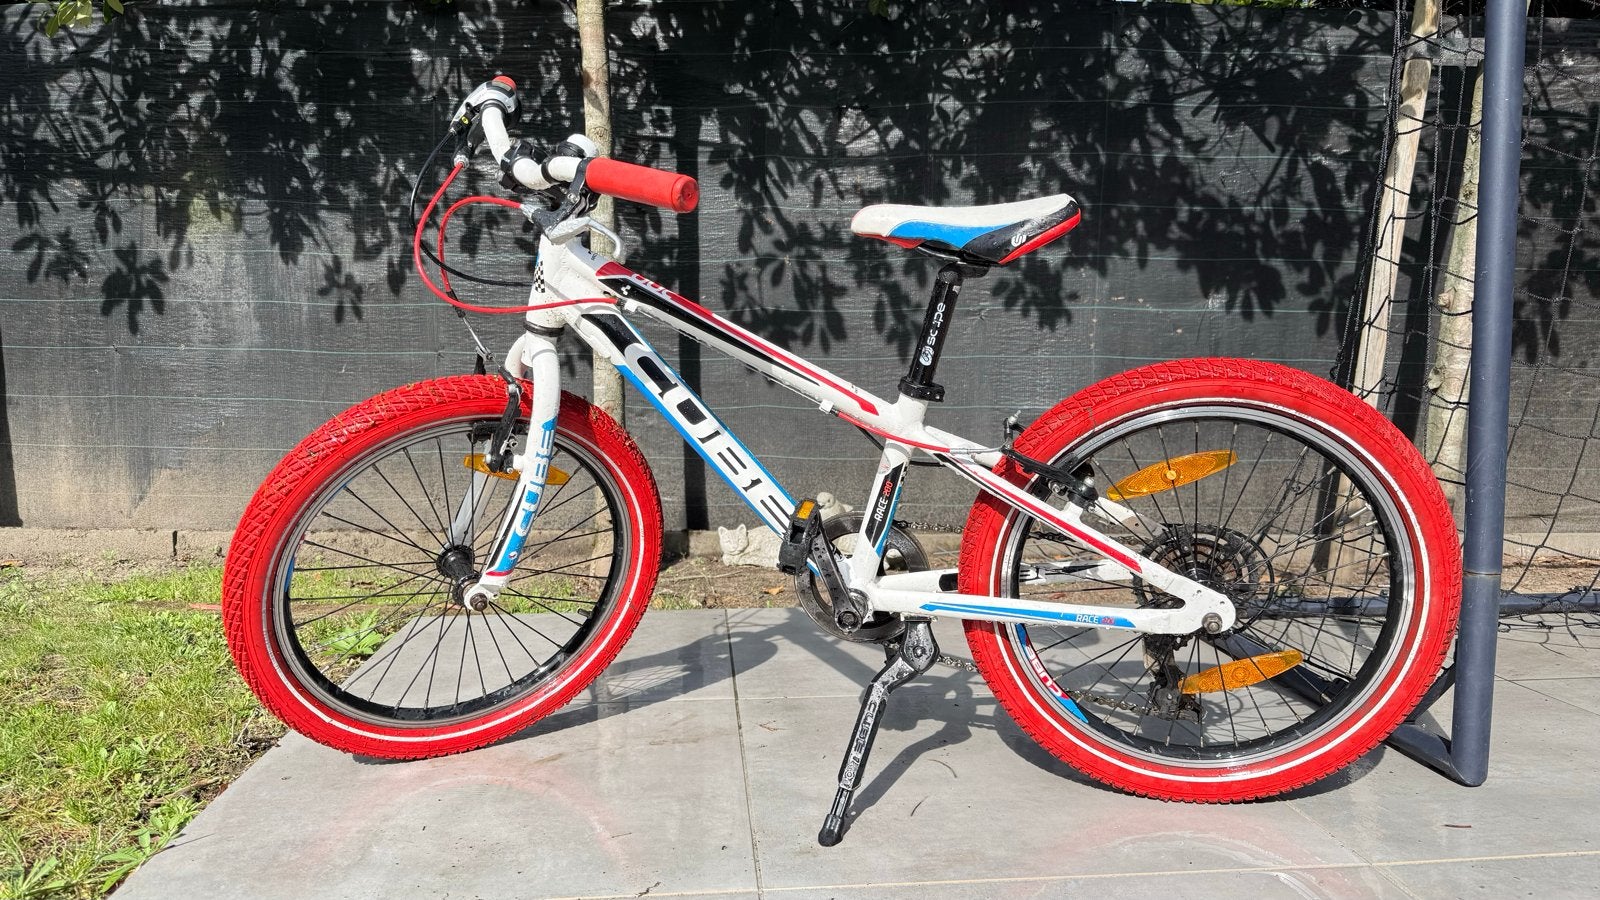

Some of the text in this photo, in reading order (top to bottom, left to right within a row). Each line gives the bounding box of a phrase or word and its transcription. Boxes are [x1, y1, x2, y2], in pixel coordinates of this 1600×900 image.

[621, 343, 796, 538] CUBE
[514, 428, 558, 537] CUBE
[874, 497, 888, 522] RACE
[1075, 613, 1099, 624] RACE
